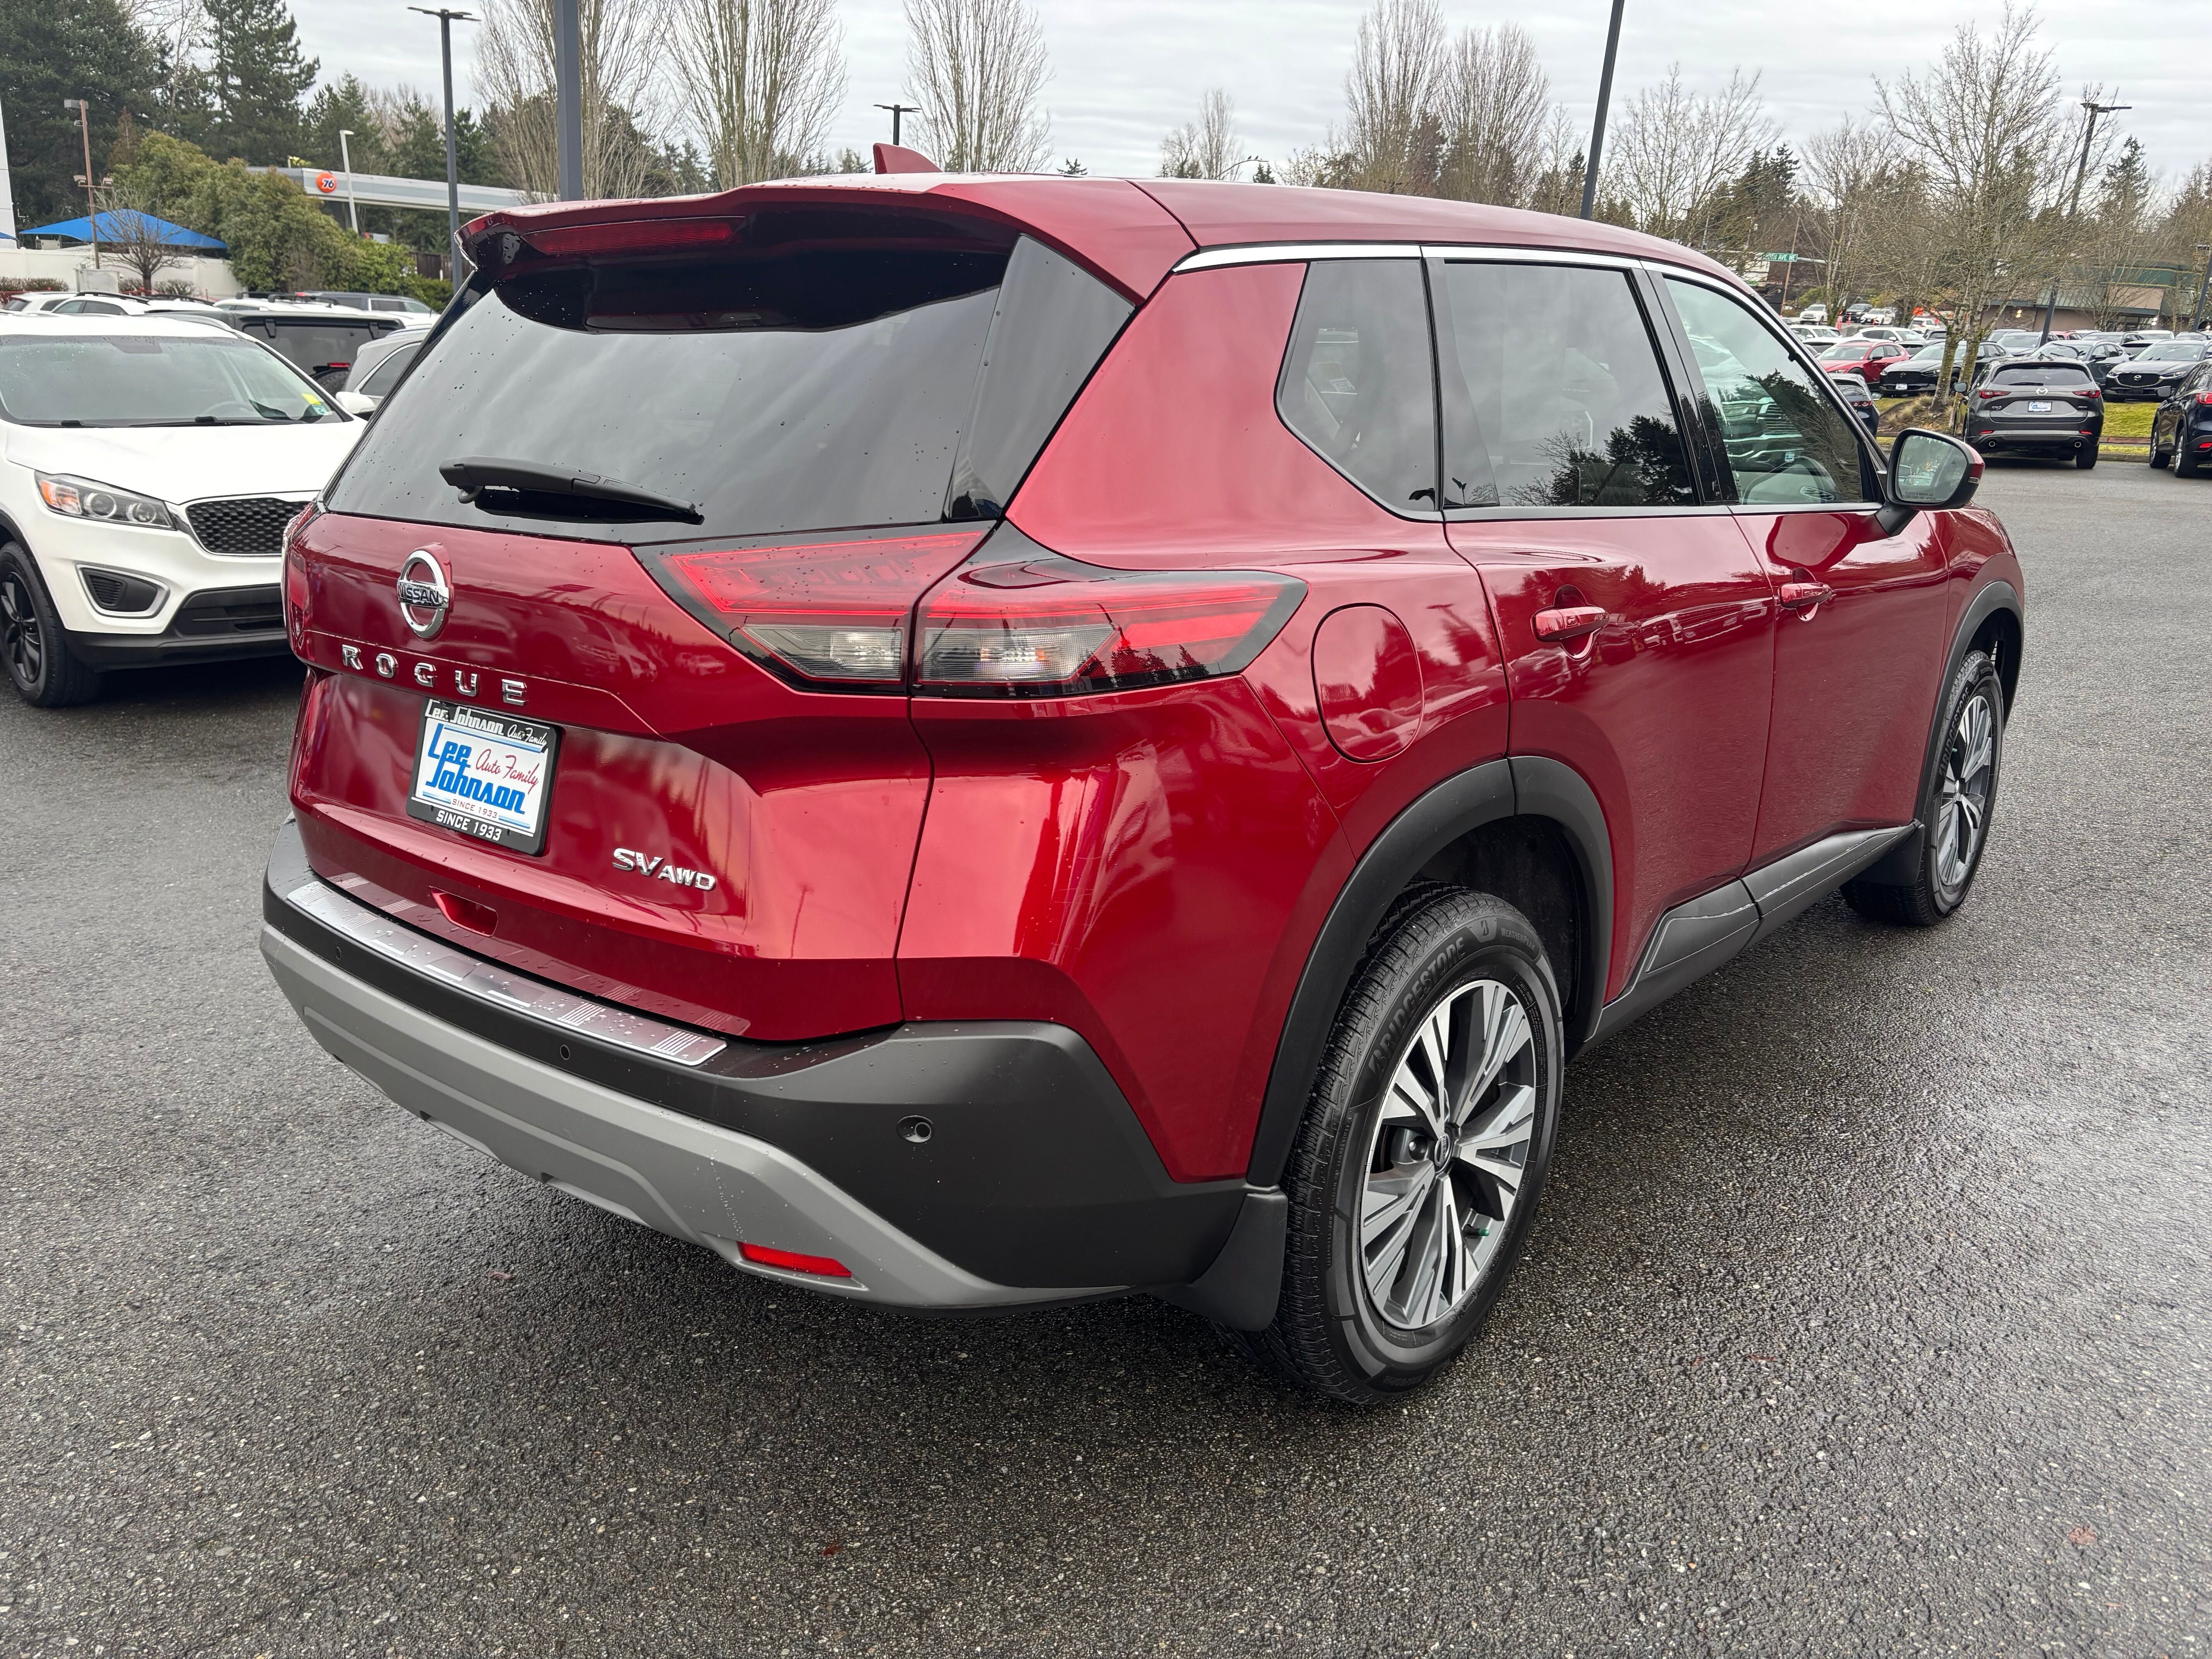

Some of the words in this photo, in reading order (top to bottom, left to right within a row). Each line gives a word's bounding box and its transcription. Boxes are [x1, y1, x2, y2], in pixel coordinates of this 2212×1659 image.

[323, 179, 335, 189] 76
[398, 584, 439, 603] NISSAN
[342, 644, 527, 706] ROGUE
[425, 699, 449, 722] Lee
[450, 706, 504, 736] Johnson
[507, 724, 526, 740] Aut
[525, 727, 547, 748] Family
[428, 723, 472, 768] Lee
[1938, 687, 1969, 776] BRIDGESTONE
[425, 759, 526, 815] Johnson
[476, 748, 501, 775] Auto
[503, 755, 539, 795] Family
[436, 810, 471, 831] SINCE
[473, 821, 502, 842] 1933
[452, 799, 475, 812] SINCE
[478, 807, 498, 819] 1933
[612, 848, 665, 876] SV
[657, 865, 717, 891] AWD
[1501, 927, 1536, 952] WEATHERPEAK
[1368, 936, 1465, 1077] BRIDGESTONE
